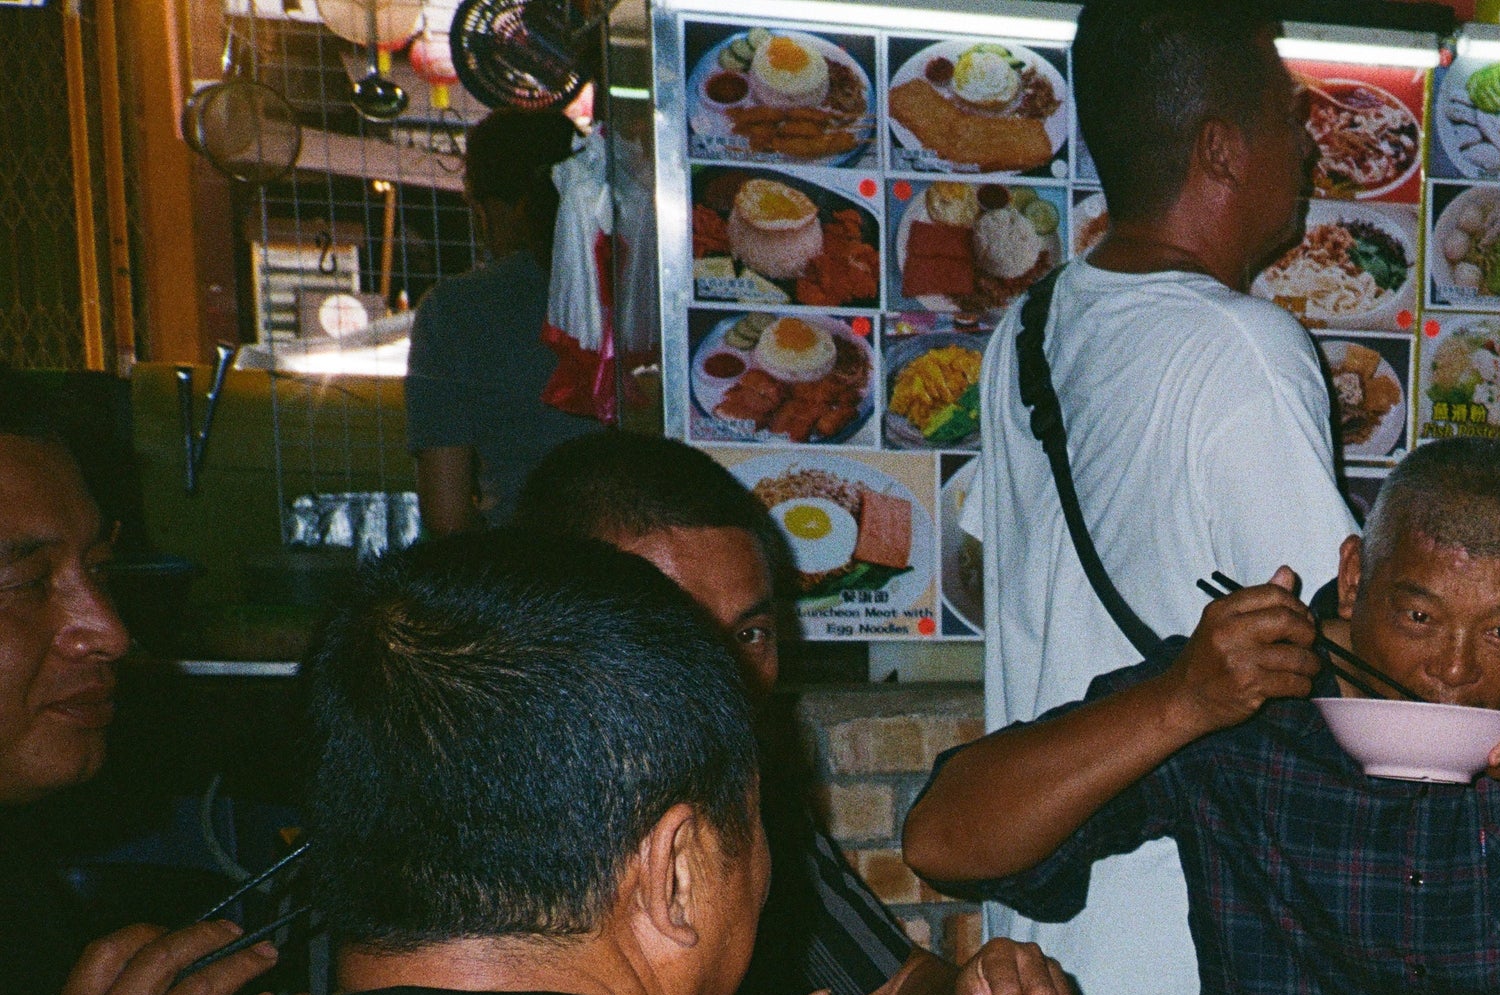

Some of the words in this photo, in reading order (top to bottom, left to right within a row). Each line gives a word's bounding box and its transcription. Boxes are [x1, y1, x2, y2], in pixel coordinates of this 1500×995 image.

[1423, 422, 1454, 438] Fish
[1457, 423, 1497, 439] Paste
[797, 606, 860, 618] Luncheon
[864, 606, 897, 618] Meat
[903, 607, 934, 618] with
[826, 622, 854, 636] Egg
[859, 622, 910, 635] Noodles
